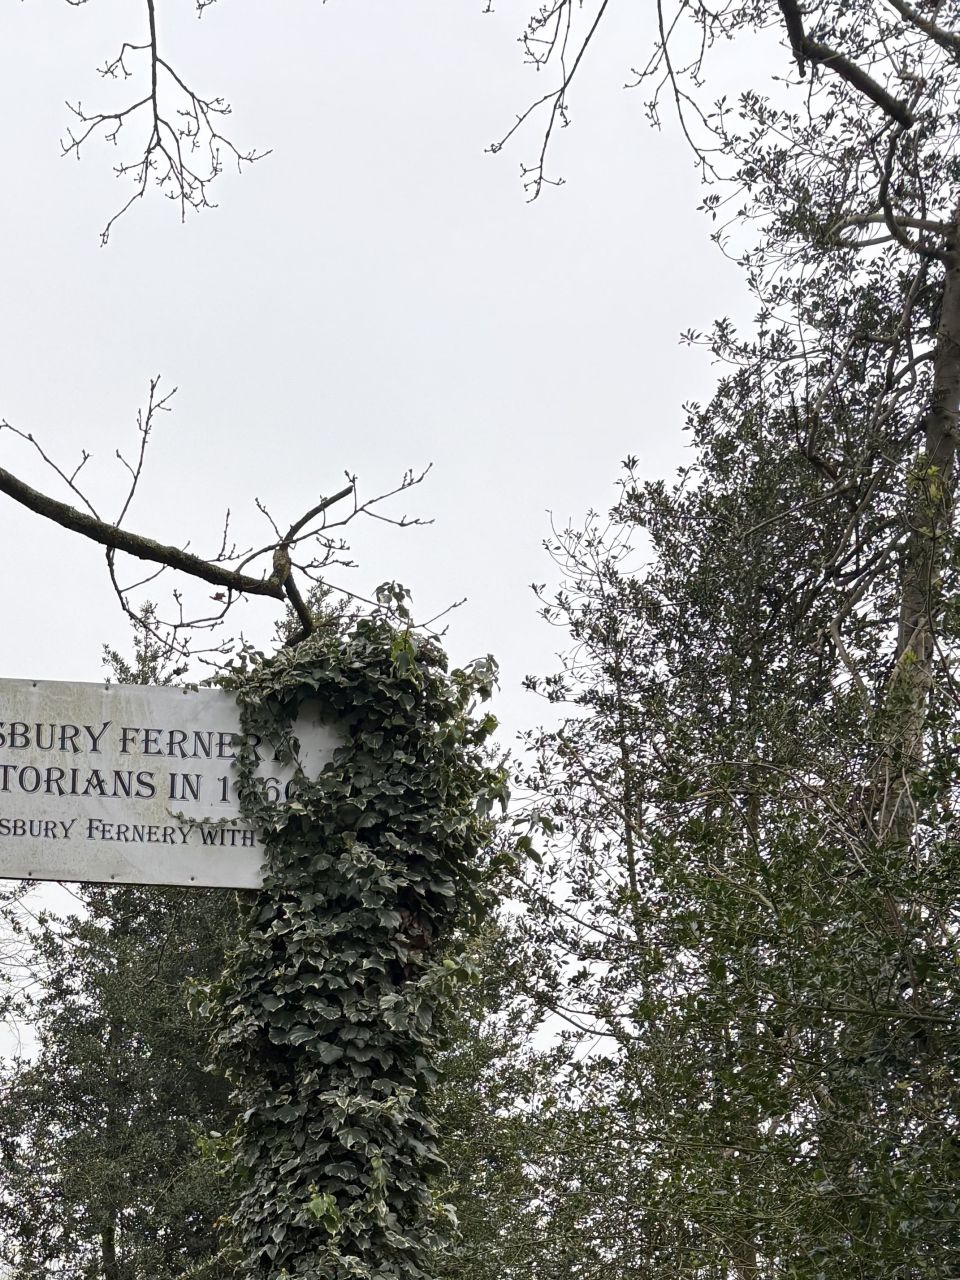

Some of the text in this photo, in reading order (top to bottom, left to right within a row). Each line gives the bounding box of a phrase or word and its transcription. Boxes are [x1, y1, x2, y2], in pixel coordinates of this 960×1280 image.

[168, 773, 202, 803] IN
[86, 818, 193, 845] FERNERY
[200, 827, 256, 848] WITH
